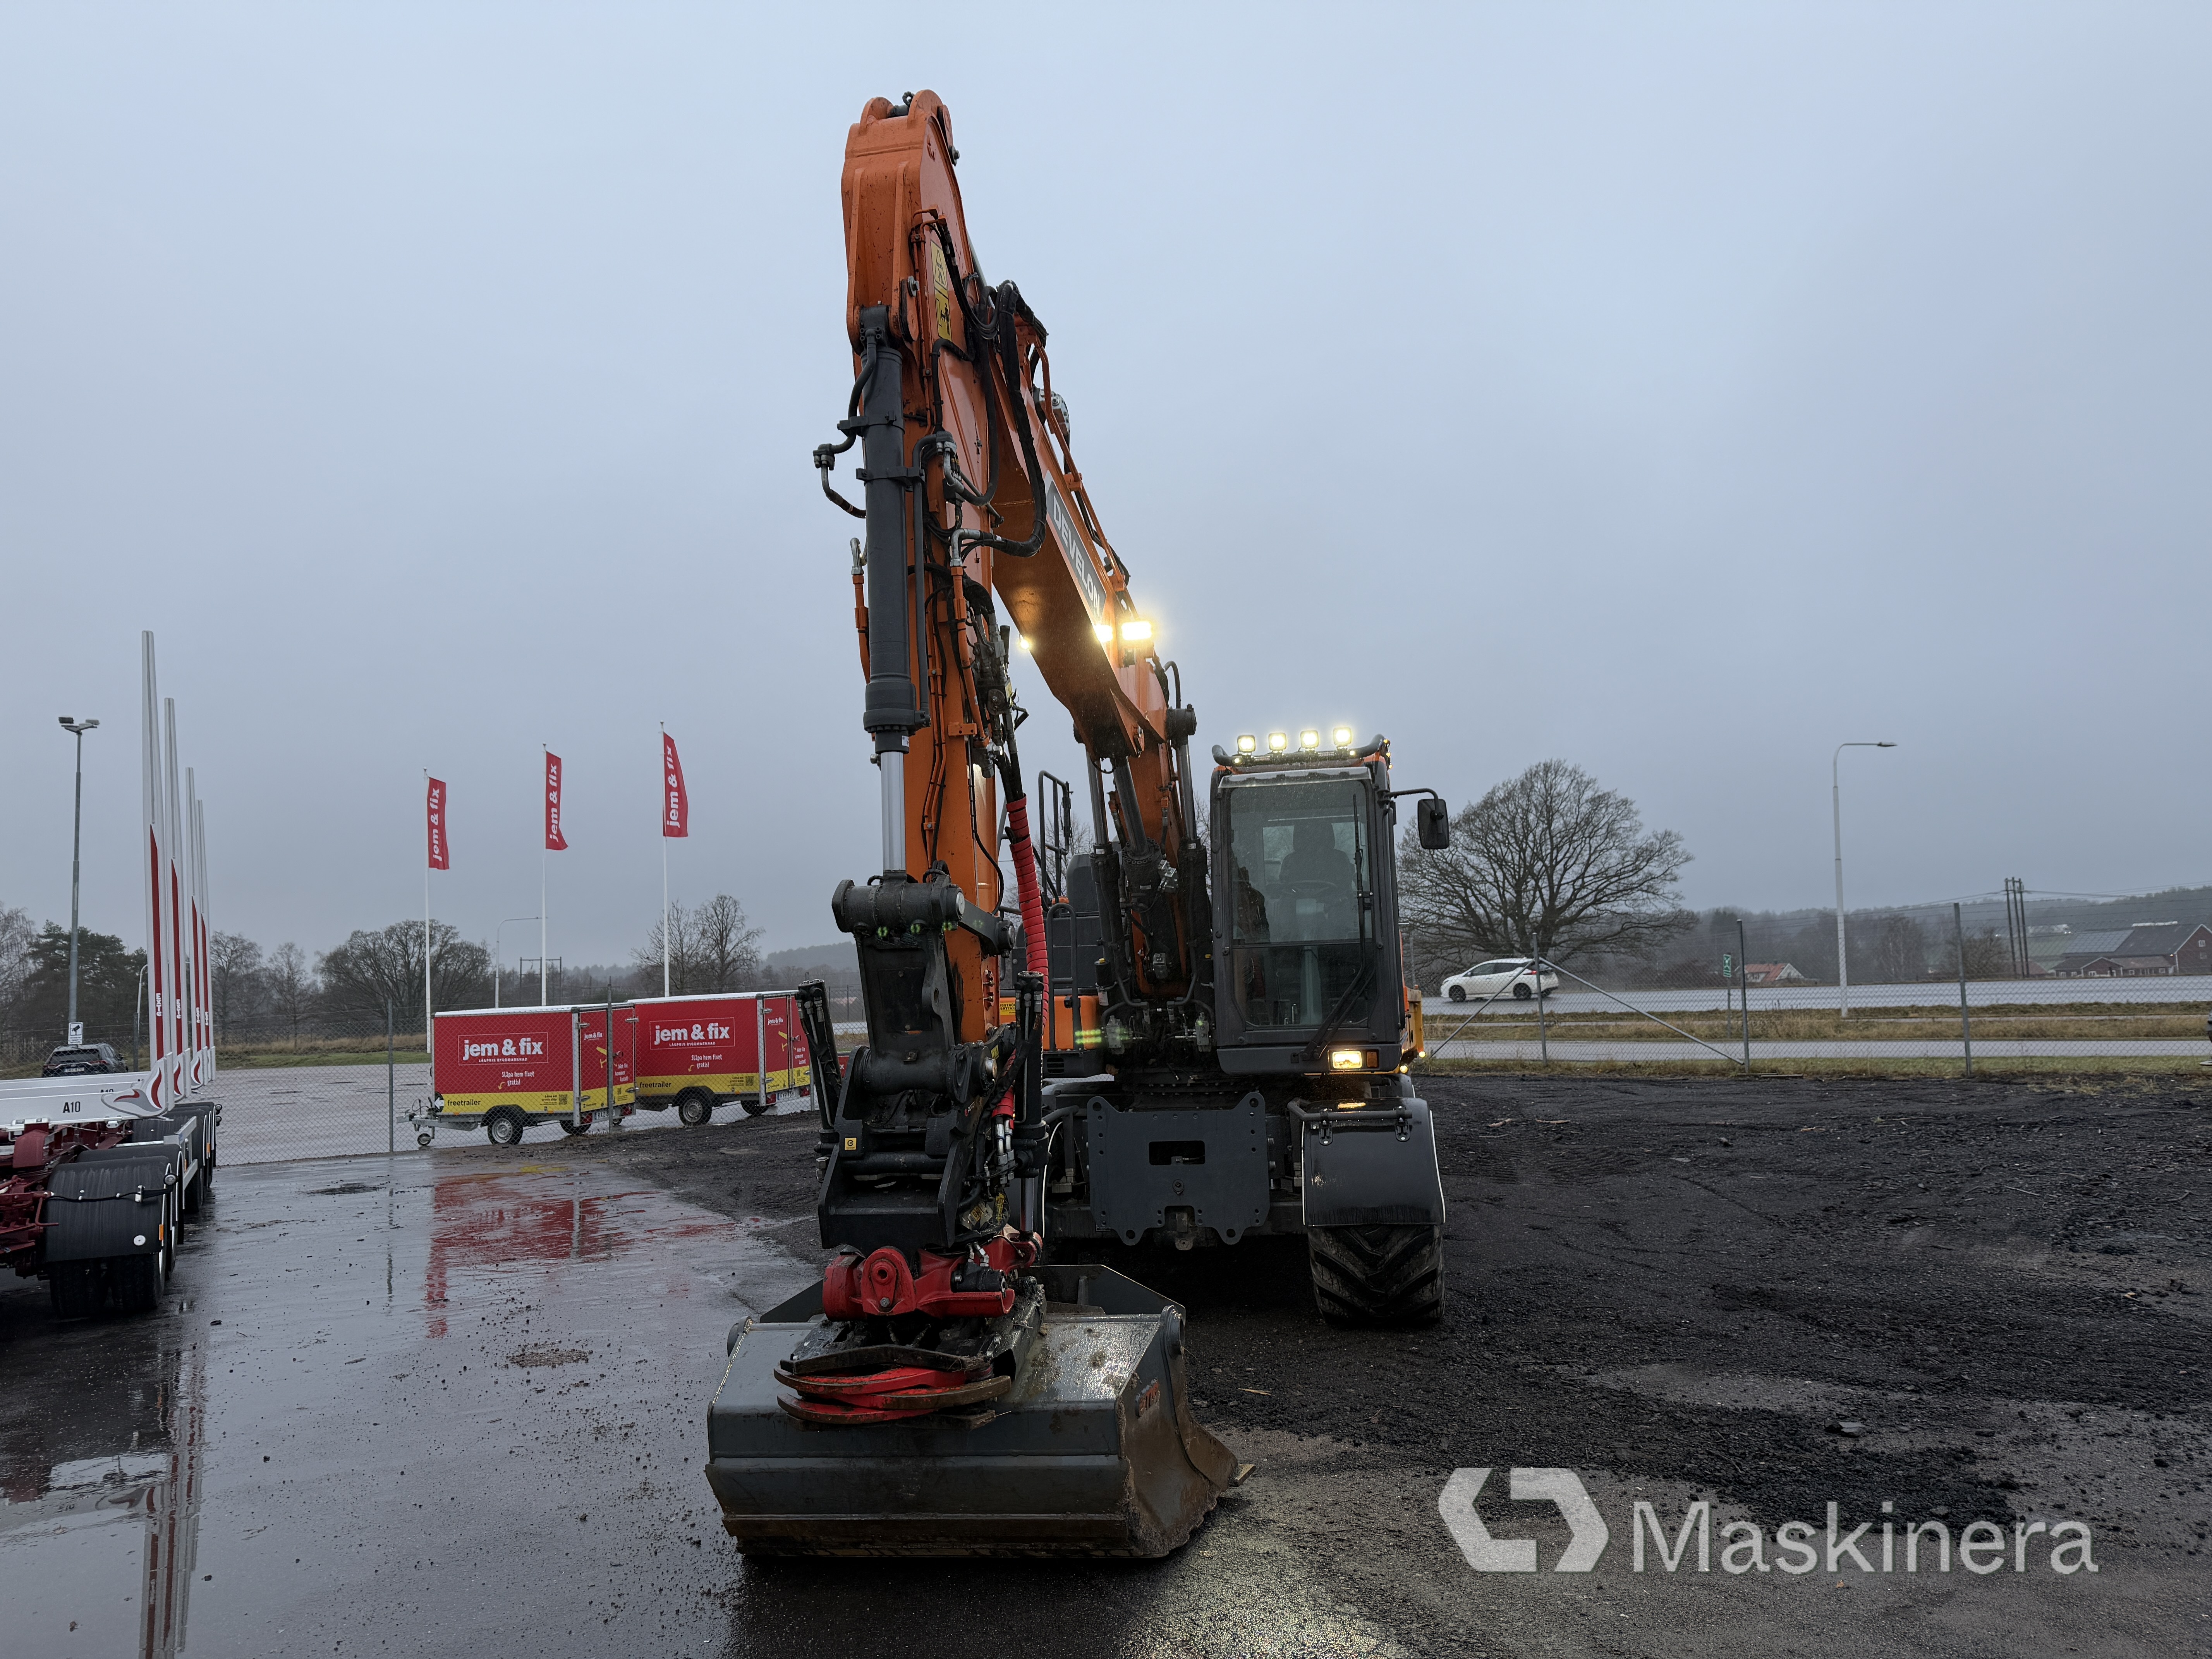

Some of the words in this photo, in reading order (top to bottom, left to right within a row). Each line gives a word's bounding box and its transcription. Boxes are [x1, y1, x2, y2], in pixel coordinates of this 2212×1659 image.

[1053, 495, 1100, 617] DEVELON
[549, 763, 557, 787] fix
[668, 773, 678, 788] &
[429, 788, 440, 810] fix
[549, 792, 558, 804] &
[666, 791, 680, 828] jem
[430, 814, 439, 825] &
[549, 807, 559, 843] jem
[432, 828, 442, 861] jem
[654, 1025, 688, 1045] jem
[691, 1024, 705, 1040] &
[707, 1022, 730, 1039] fix
[463, 1039, 498, 1061] jem
[502, 1039, 517, 1056] &
[519, 1037, 543, 1055] fix
[63, 1101, 81, 1113] A10
